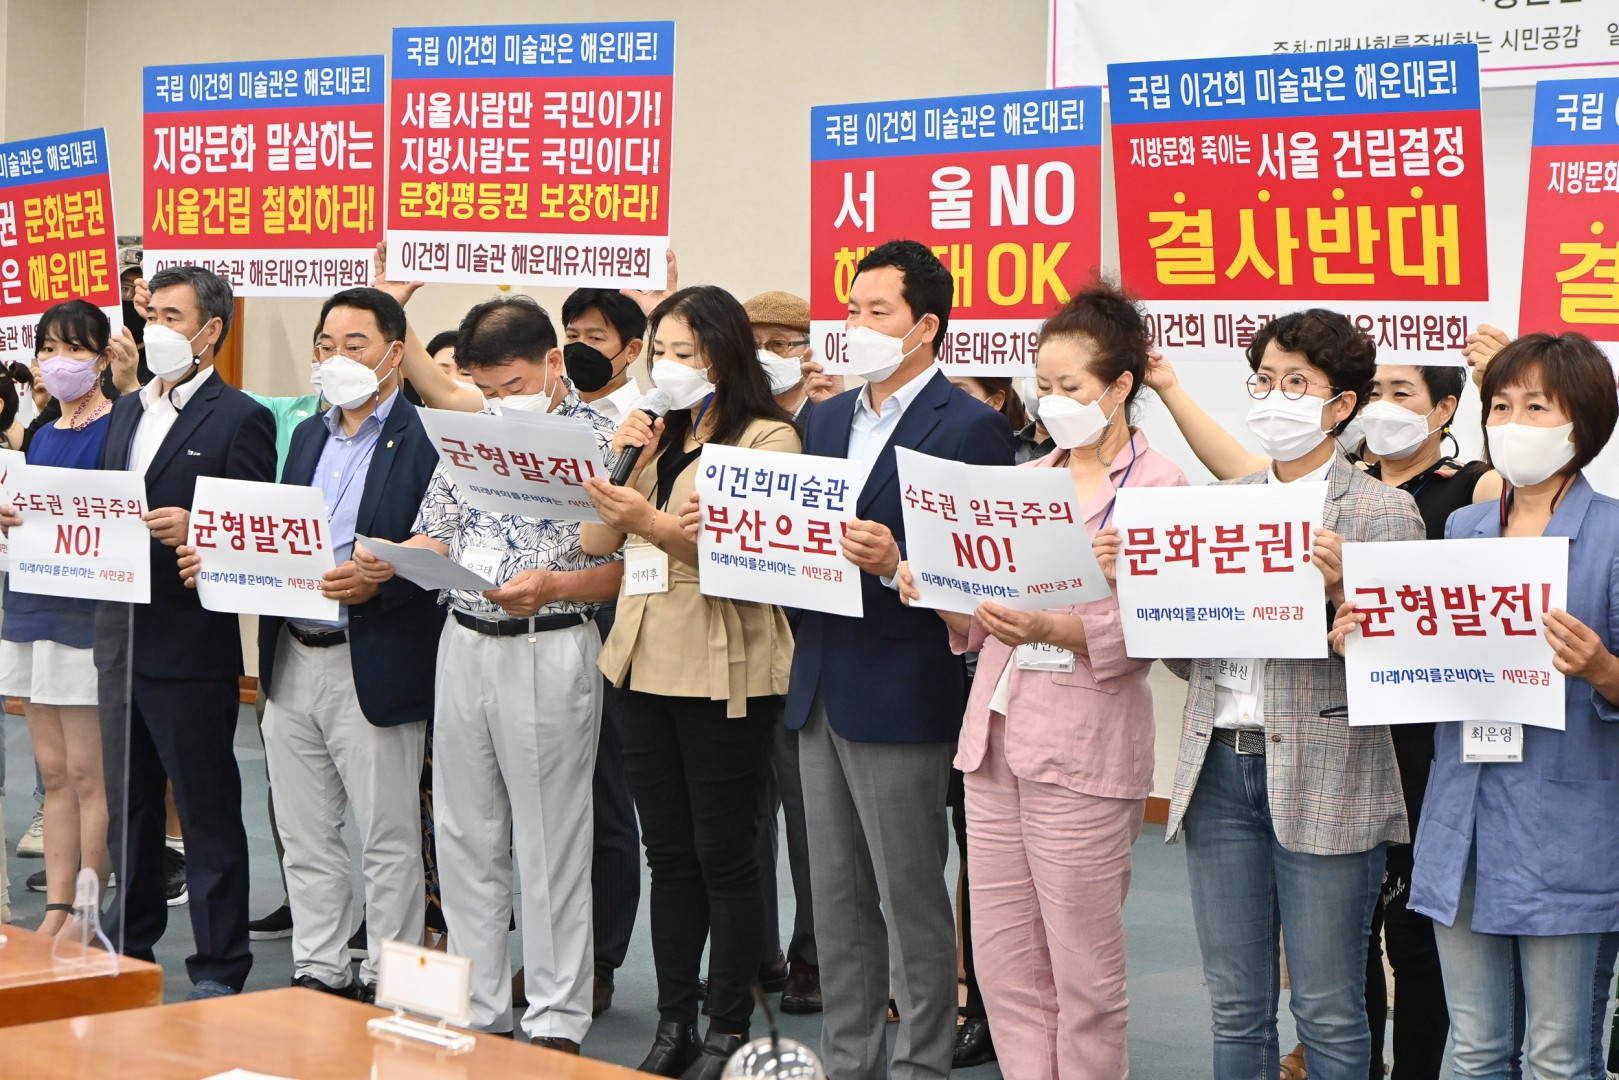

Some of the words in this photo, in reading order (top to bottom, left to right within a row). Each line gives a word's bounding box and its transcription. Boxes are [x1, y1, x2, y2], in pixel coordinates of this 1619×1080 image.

[406, 36, 440, 66] 국립
[446, 35, 497, 65] 이건희
[504, 33, 573, 64] 미술관은
[580, 31, 658, 64] 해운대로!
[1500, 24, 1581, 51] 시민공감
[155, 75, 183, 102] 국립
[190, 72, 232, 101] 이건희
[239, 69, 298, 99] 미술관은
[304, 66, 371, 96] 해운대로!
[1128, 75, 1170, 110] 국립
[1180, 70, 1246, 108] 이건희
[1255, 65, 1346, 104] 미술관은
[1355, 60, 1457, 100] 해운대로!
[400, 91, 534, 129] 서울사람만
[543, 90, 662, 129] 국민이가!
[825, 114, 858, 146] 국립
[865, 110, 917, 144] 이건희
[924, 104, 996, 141] 미술관은
[1003, 99, 1085, 136] 해운대로!
[1556, 93, 1604, 131] 국립
[46, 140, 98, 172] 해운대로!
[152, 124, 256, 175] 지방문화
[266, 120, 373, 172] 말살하는
[400, 137, 530, 175] 지방사람도
[541, 137, 660, 176] 국민이다!
[1129, 135, 1195, 168] 지방문화
[1201, 134, 1251, 165] 죽이는
[1257, 131, 1319, 180] 서울
[1332, 126, 1465, 178] 건립결정
[989, 160, 1075, 227] NO
[1547, 160, 1619, 194] 지방문화
[23, 188, 105, 244] 문화분권
[151, 186, 250, 235] 서울건립
[262, 183, 375, 235] 철회하라!
[399, 181, 529, 220] 문화평등권
[539, 182, 659, 222] 보장하라!
[401, 241, 450, 272] 이건희
[456, 243, 507, 274] 미술관
[511, 244, 651, 278] 해운대유치위원회
[1148, 204, 1461, 285] 결사반대
[28, 248, 110, 302] 해운대로
[249, 259, 369, 287] 해운대유치위원회
[987, 241, 1072, 306] OK
[1145, 313, 1205, 348] 이건희
[441, 437, 595, 487] 균형발전!
[12, 492, 64, 516] 수도권
[72, 496, 142, 519] 일극주의
[468, 484, 564, 506] 미래사회를준비하는
[567, 499, 595, 509] 시민
[706, 464, 849, 512] 이건희미술관
[905, 484, 958, 523] 수도권
[969, 499, 1074, 528] 일극주의
[54, 524, 101, 557] NO!
[193, 509, 322, 556] 균형발전!
[1124, 521, 1311, 576] 문화분권!
[711, 551, 796, 576] 미래사회를준비하는
[801, 565, 843, 582] 시민공감
[951, 532, 1017, 573] NO!
[19, 562, 95, 579] 미래사회를준비하는
[99, 569, 135, 583] 시민공감
[200, 571, 283, 588] 미래사회를준비하는
[631, 567, 659, 583] 이지후
[921, 572, 1020, 598] 미래사회를준비하는
[1027, 578, 1083, 595] 시민공감
[1136, 607, 1246, 622] 미래사회를준비하는
[1252, 606, 1304, 621] 시민공감
[1352, 583, 1551, 638] 균형발전!
[1370, 668, 1496, 684] 미래사회를준비하는
[1502, 669, 1551, 687] 시민공감
[1471, 726, 1512, 743] 최은영
